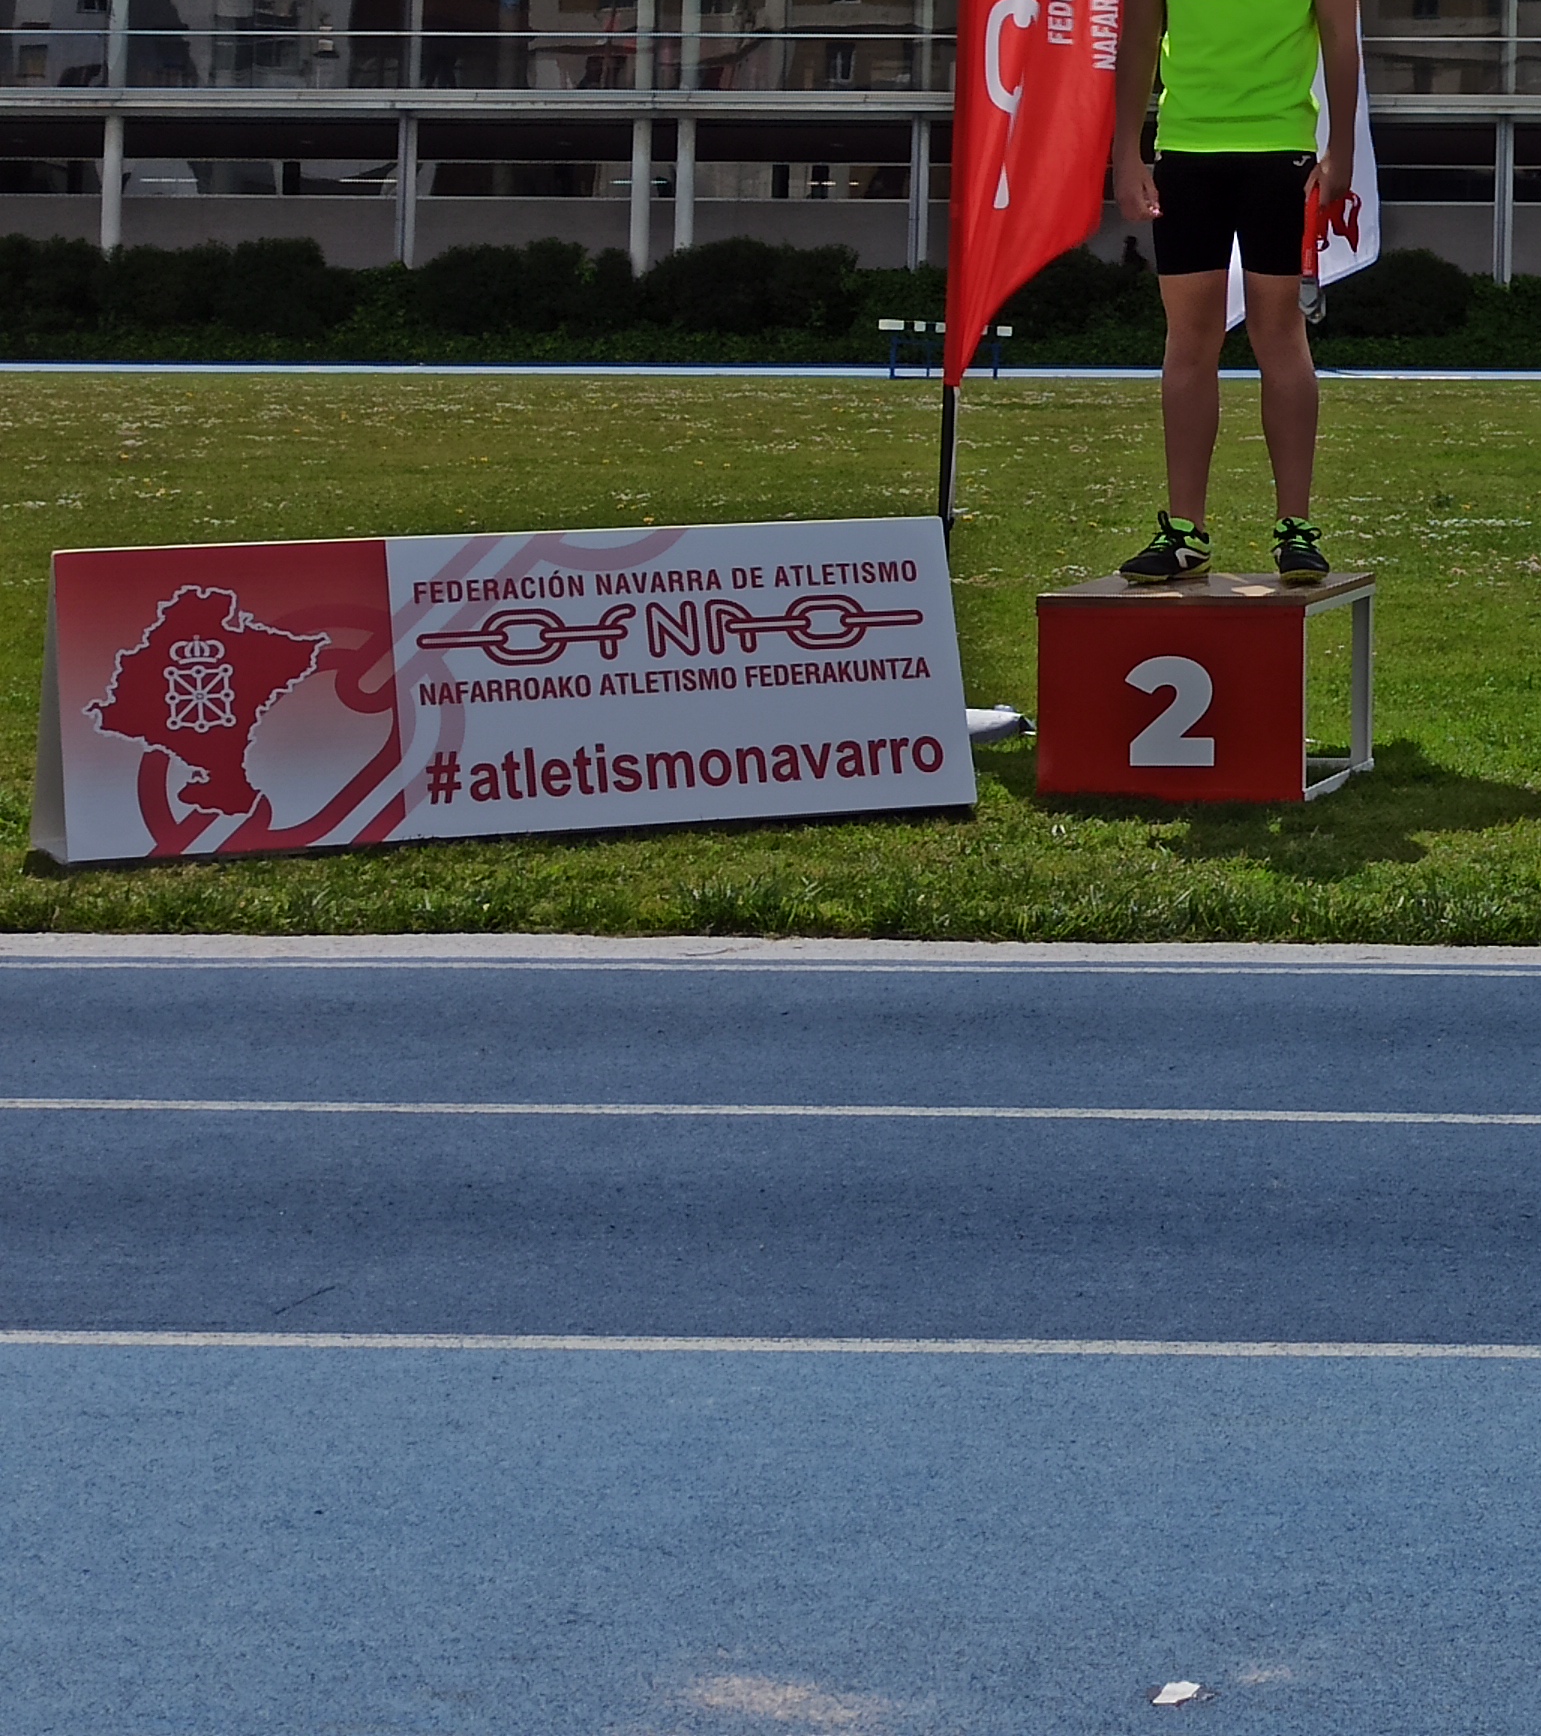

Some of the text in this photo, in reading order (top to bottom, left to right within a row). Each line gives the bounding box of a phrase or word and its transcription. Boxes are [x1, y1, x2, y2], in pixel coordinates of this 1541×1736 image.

[413, 559, 918, 605] FEDERACIÓN NAVARRA DE ATLETISMO
[419, 657, 931, 707] NAFARROAKO ATLETISMO FEDERAKUNTZA
[1124, 654, 1215, 767] 2
[426, 733, 946, 806] #atletismonavarro
